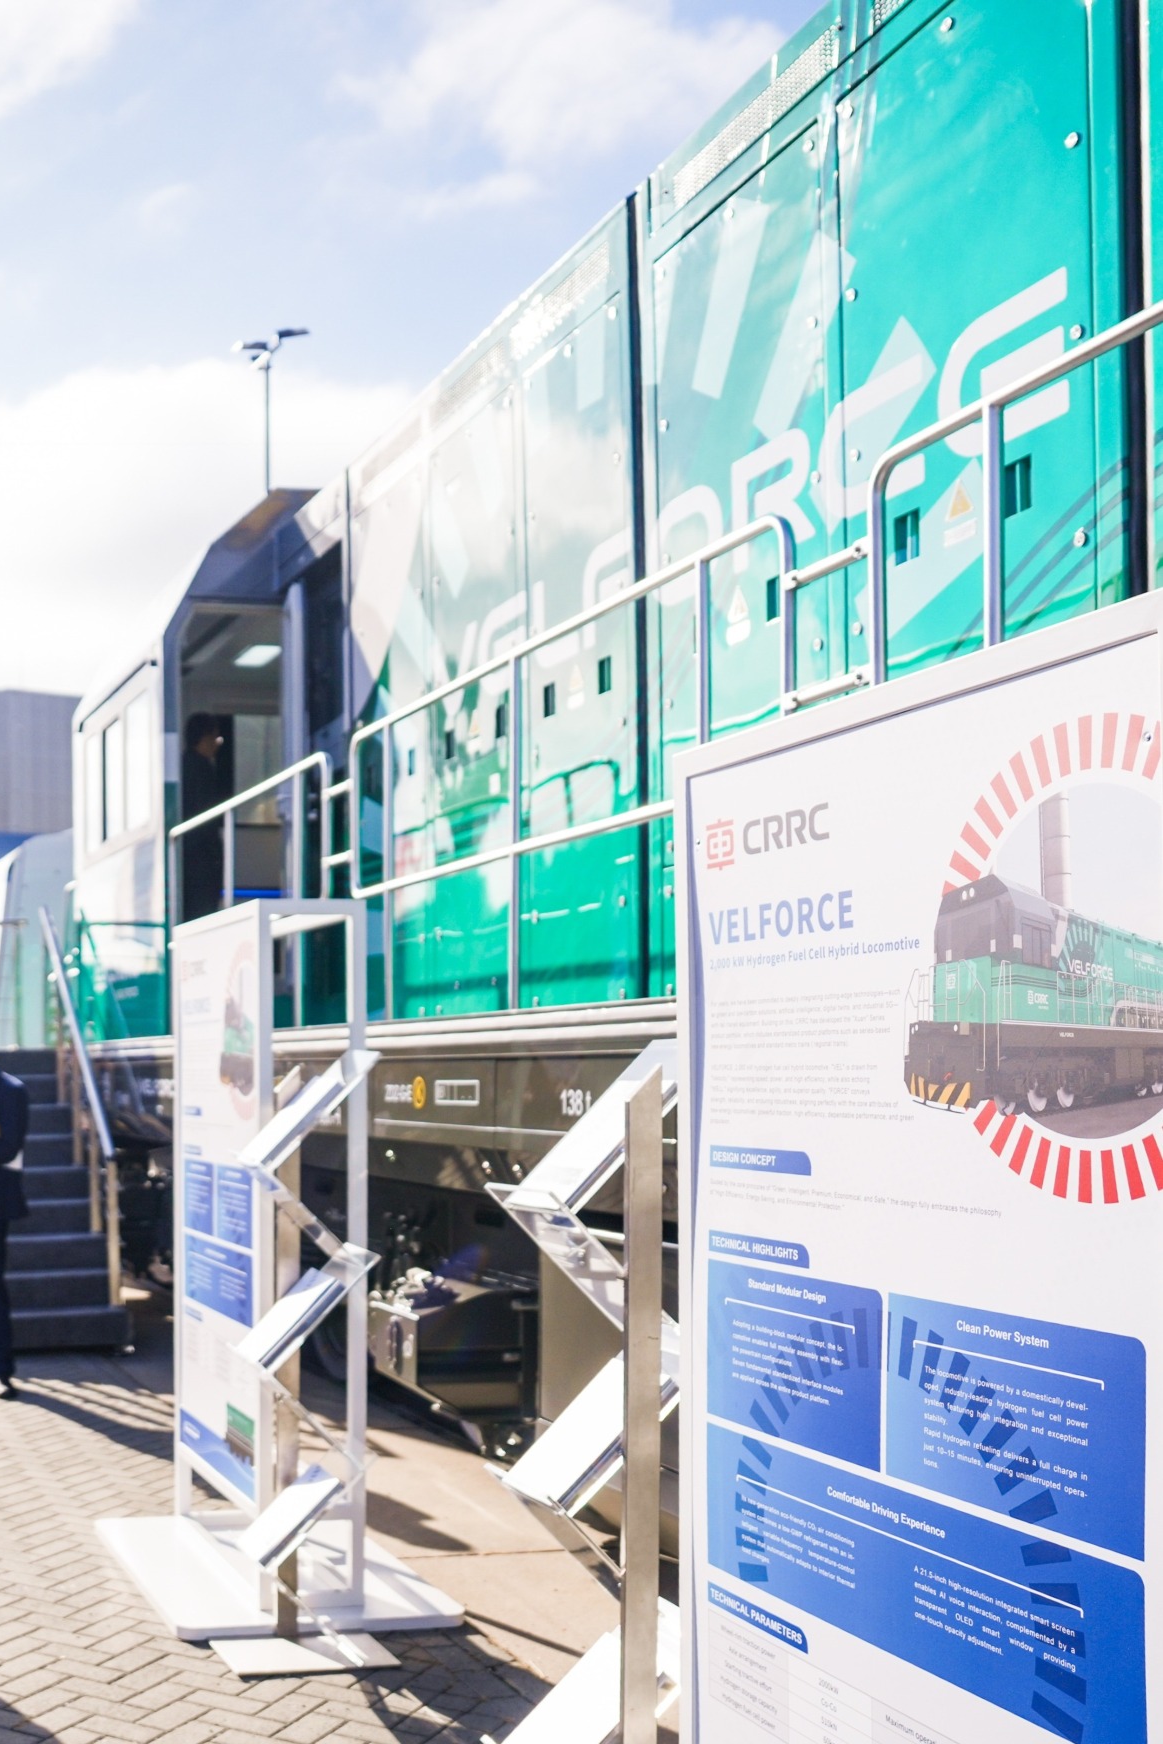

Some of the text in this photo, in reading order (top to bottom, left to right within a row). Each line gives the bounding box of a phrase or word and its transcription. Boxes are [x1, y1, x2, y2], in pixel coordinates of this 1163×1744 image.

[743, 802, 830, 855] CRRC
[709, 890, 854, 945] VELFORCE
[710, 935, 920, 972] 2,000 kW Hydrogen Fuel Cell Hybrid Locomotive
[1068, 959, 1113, 980] VELFORCE
[559, 1089, 584, 1116] 138
[713, 1151, 776, 1166] DESIGN CONCEPT
[712, 1236, 798, 1260] TECHNICAL HIGHLIGHTS
[748, 1278, 826, 1304] Standard Modular Design
[956, 1320, 1049, 1348] Clean Power System
[925, 1365, 936, 1376] The
[937, 1368, 969, 1383] locomotive
[977, 1377, 1005, 1393] powered
[1006, 1385, 1014, 1395] by
[1022, 1389, 1064, 1407] domestically
[1066, 1400, 1088, 1411] devel-
[944, 1388, 993, 1407] industry-leading
[997, 1399, 1027, 1413] hydrogen
[1031, 1408, 1044, 1418] fuel
[1049, 1414, 1061, 1422] cell
[1066, 1418, 1088, 1429] power
[924, 1397, 1088, 1446] system featuring high integration and exceptional
[923, 1443, 934, 1452] just
[985, 1462, 1013, 1477] ensuring
[1016, 1472, 1061, 1490] uninterrupted
[1064, 1486, 1087, 1497] opera-
[924, 1427, 940, 1438] Rapid
[942, 1432, 971, 1446] hydrogen
[973, 1440, 1001, 1458] refueling
[1003, 1450, 1029, 1464] delivers
[1039, 1460, 1050, 1470] full
[1053, 1465, 1077, 1478] charge
[827, 1486, 945, 1538] Comfortable Driving Experience
[710, 1587, 802, 1644] TECHNICAL PARAMETERS
[914, 1565, 1075, 1637] A 21.5-inch high-resolution integrated smart screen
[914, 1582, 936, 1595] enables
[949, 1596, 965, 1607] voice
[1006, 1620, 1054, 1645] complemented
[1058, 1640, 1067, 1652] by
[914, 1612, 943, 1628] one-touch
[944, 1625, 966, 1640] opacity
[914, 1596, 1076, 1673] transparent OLED smart window providing
